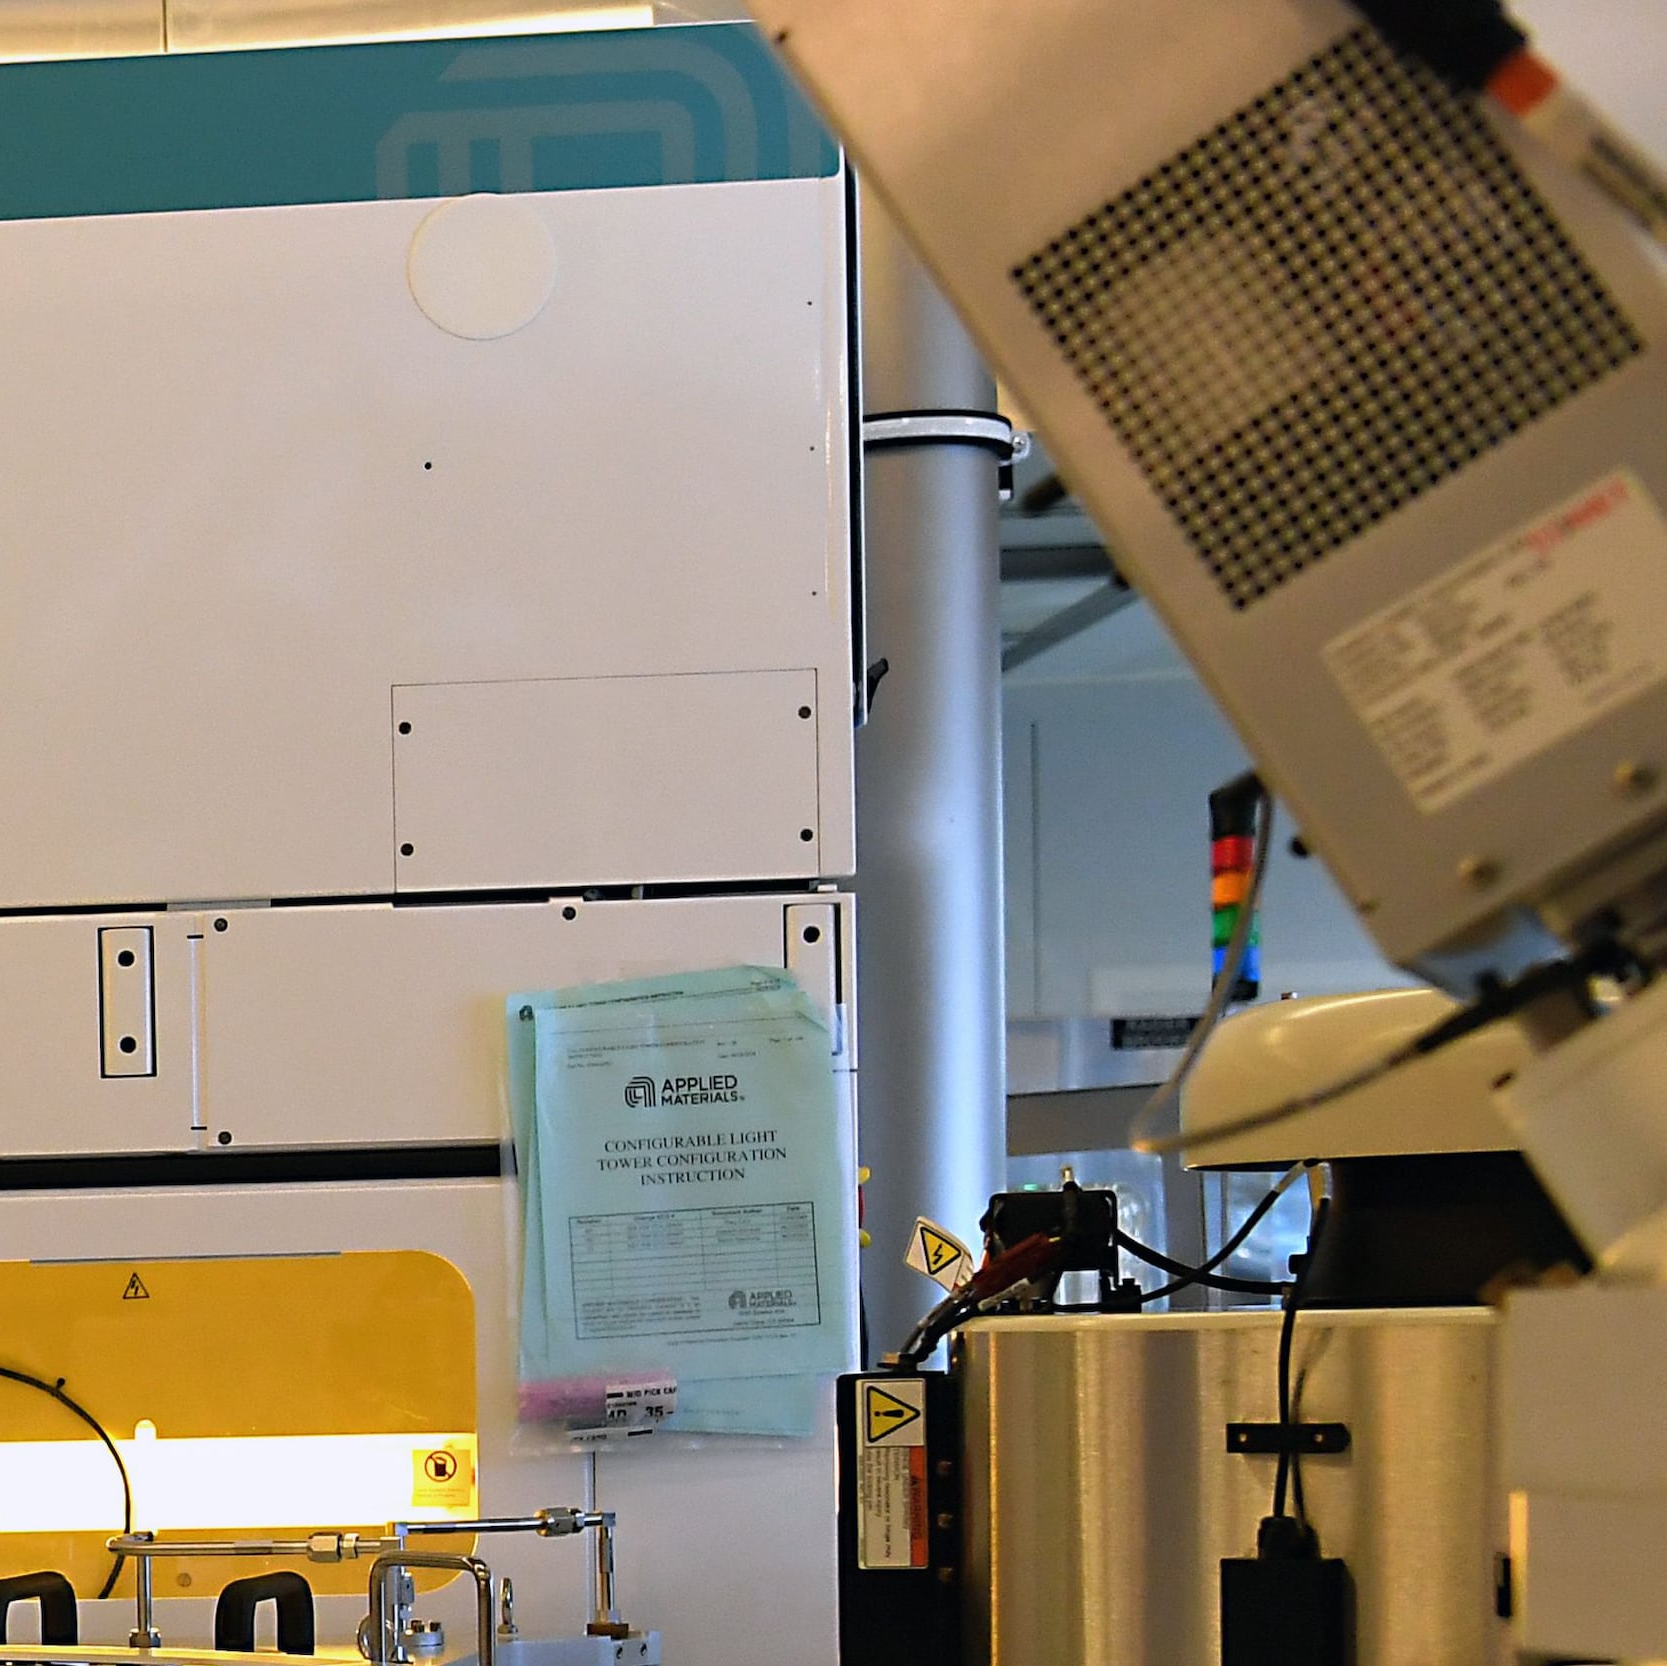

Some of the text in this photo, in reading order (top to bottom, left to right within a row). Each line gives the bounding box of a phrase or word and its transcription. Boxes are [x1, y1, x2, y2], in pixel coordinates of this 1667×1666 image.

[661, 1074, 738, 1094] APPLIED
[661, 1091, 739, 1107] MATERIALS
[604, 1130, 778, 1153] CONFIGURABLE LIGHT
[597, 1147, 787, 1171] TOWER CONFIGURATION
[641, 1168, 746, 1186] INSTRUCTION
